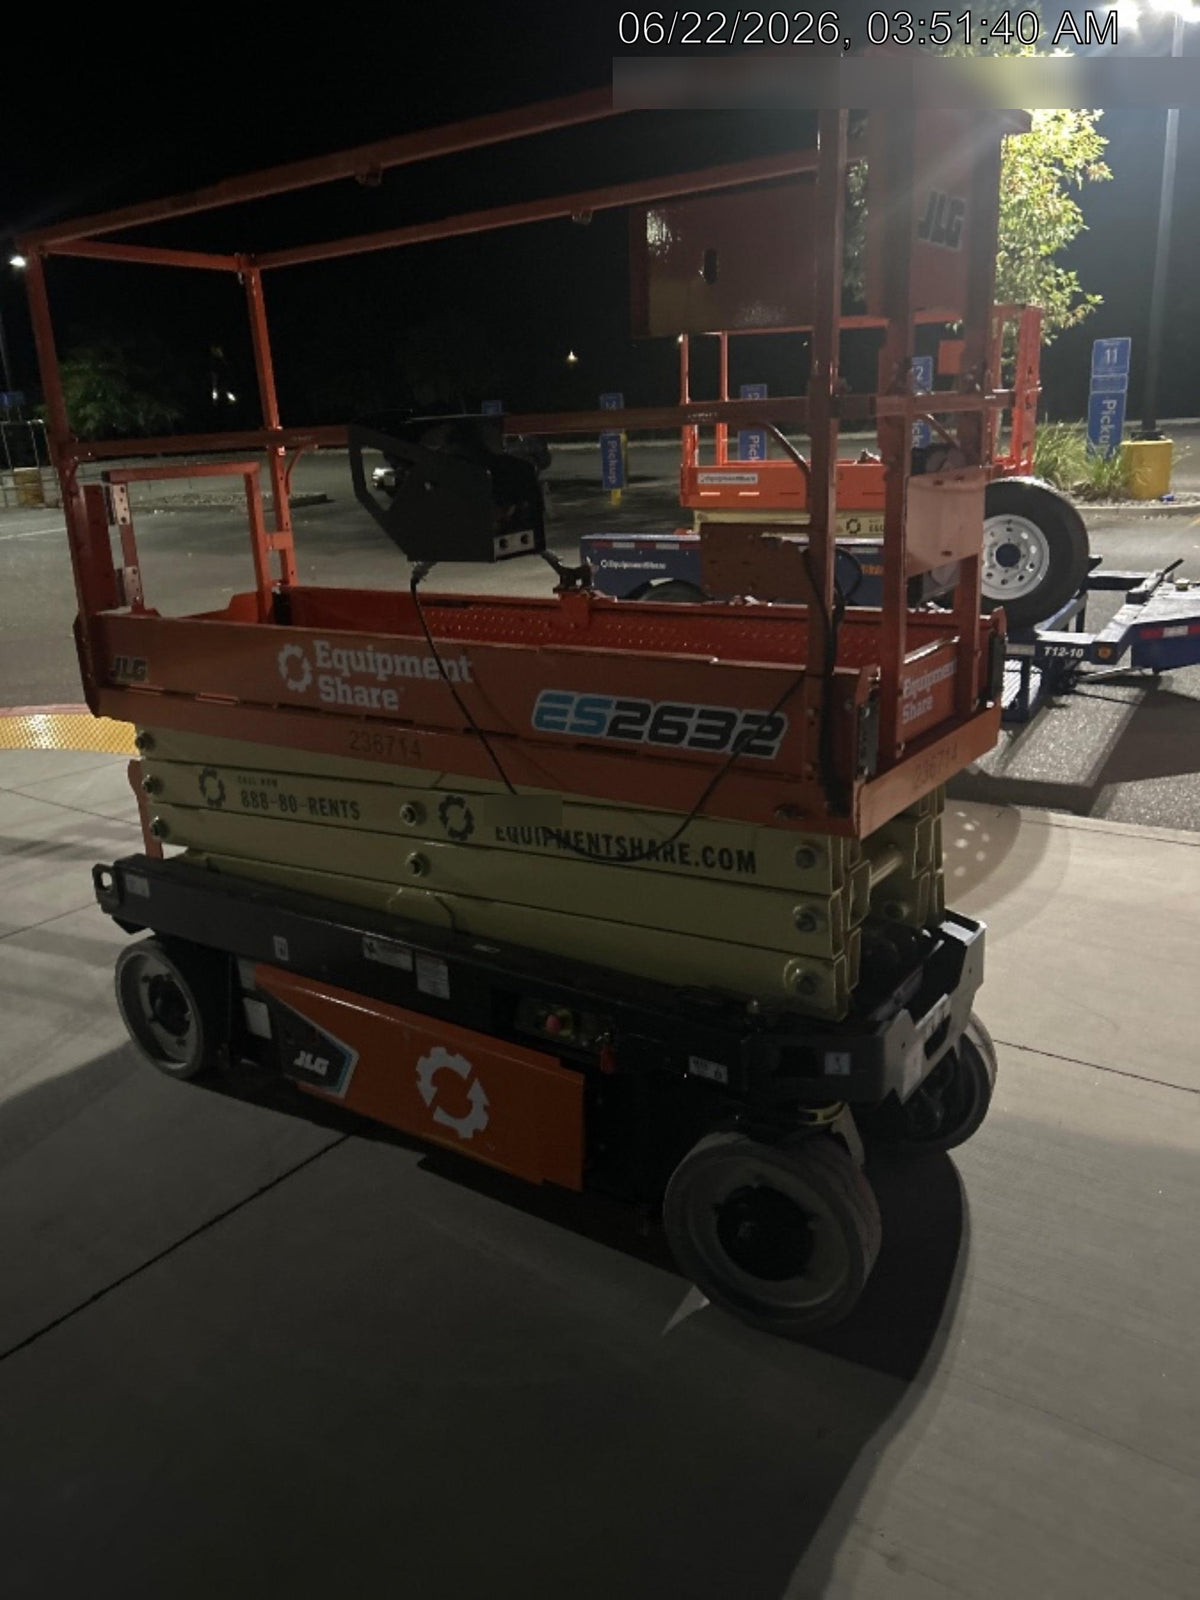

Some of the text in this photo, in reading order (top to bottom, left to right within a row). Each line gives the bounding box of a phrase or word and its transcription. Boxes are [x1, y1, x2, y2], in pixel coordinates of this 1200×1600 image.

[1105, 348, 1118, 364] 11
[1100, 399, 1118, 445] Picku
[313, 638, 474, 684] Equipment
[1043, 645, 1085, 659] T12-10
[110, 656, 148, 682] JLG
[318, 674, 400, 712] Share
[532, 690, 788, 759] ES2632
[293, 1049, 330, 1077] JLG
